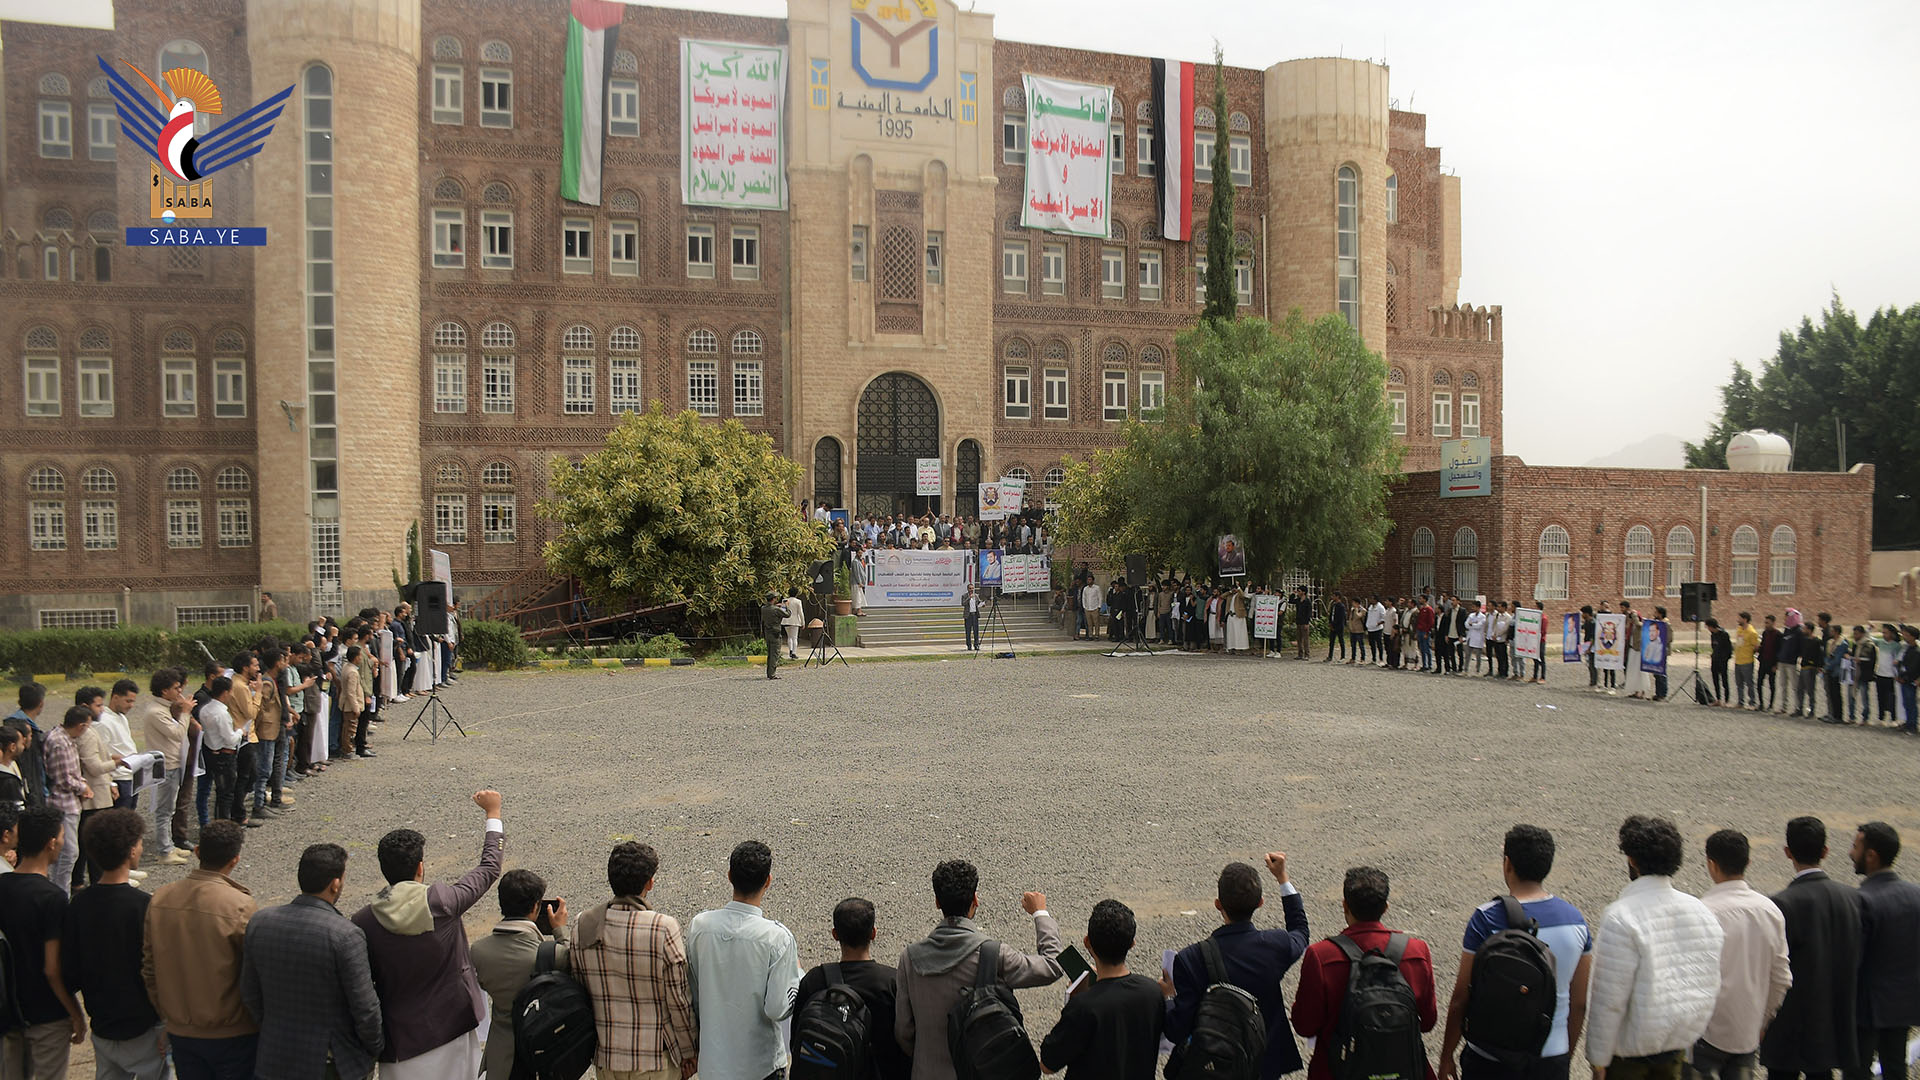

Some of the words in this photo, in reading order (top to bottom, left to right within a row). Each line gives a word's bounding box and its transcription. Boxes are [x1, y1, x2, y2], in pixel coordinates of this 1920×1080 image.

[693, 50, 744, 84] أكبر
[747, 56, 776, 81] الله
[741, 93, 776, 112] الموت
[837, 91, 892, 118] اليمنية
[895, 96, 954, 125] الجامعة
[1031, 88, 1106, 123] قاطعوا
[741, 121, 776, 140] الموت
[877, 118, 913, 139] 1995
[692, 143, 724, 164] اليهود
[727, 144, 745, 166] على
[749, 144, 776, 166] اللعنة
[739, 169, 776, 199] النصر
[1062, 164, 1068, 184] و
